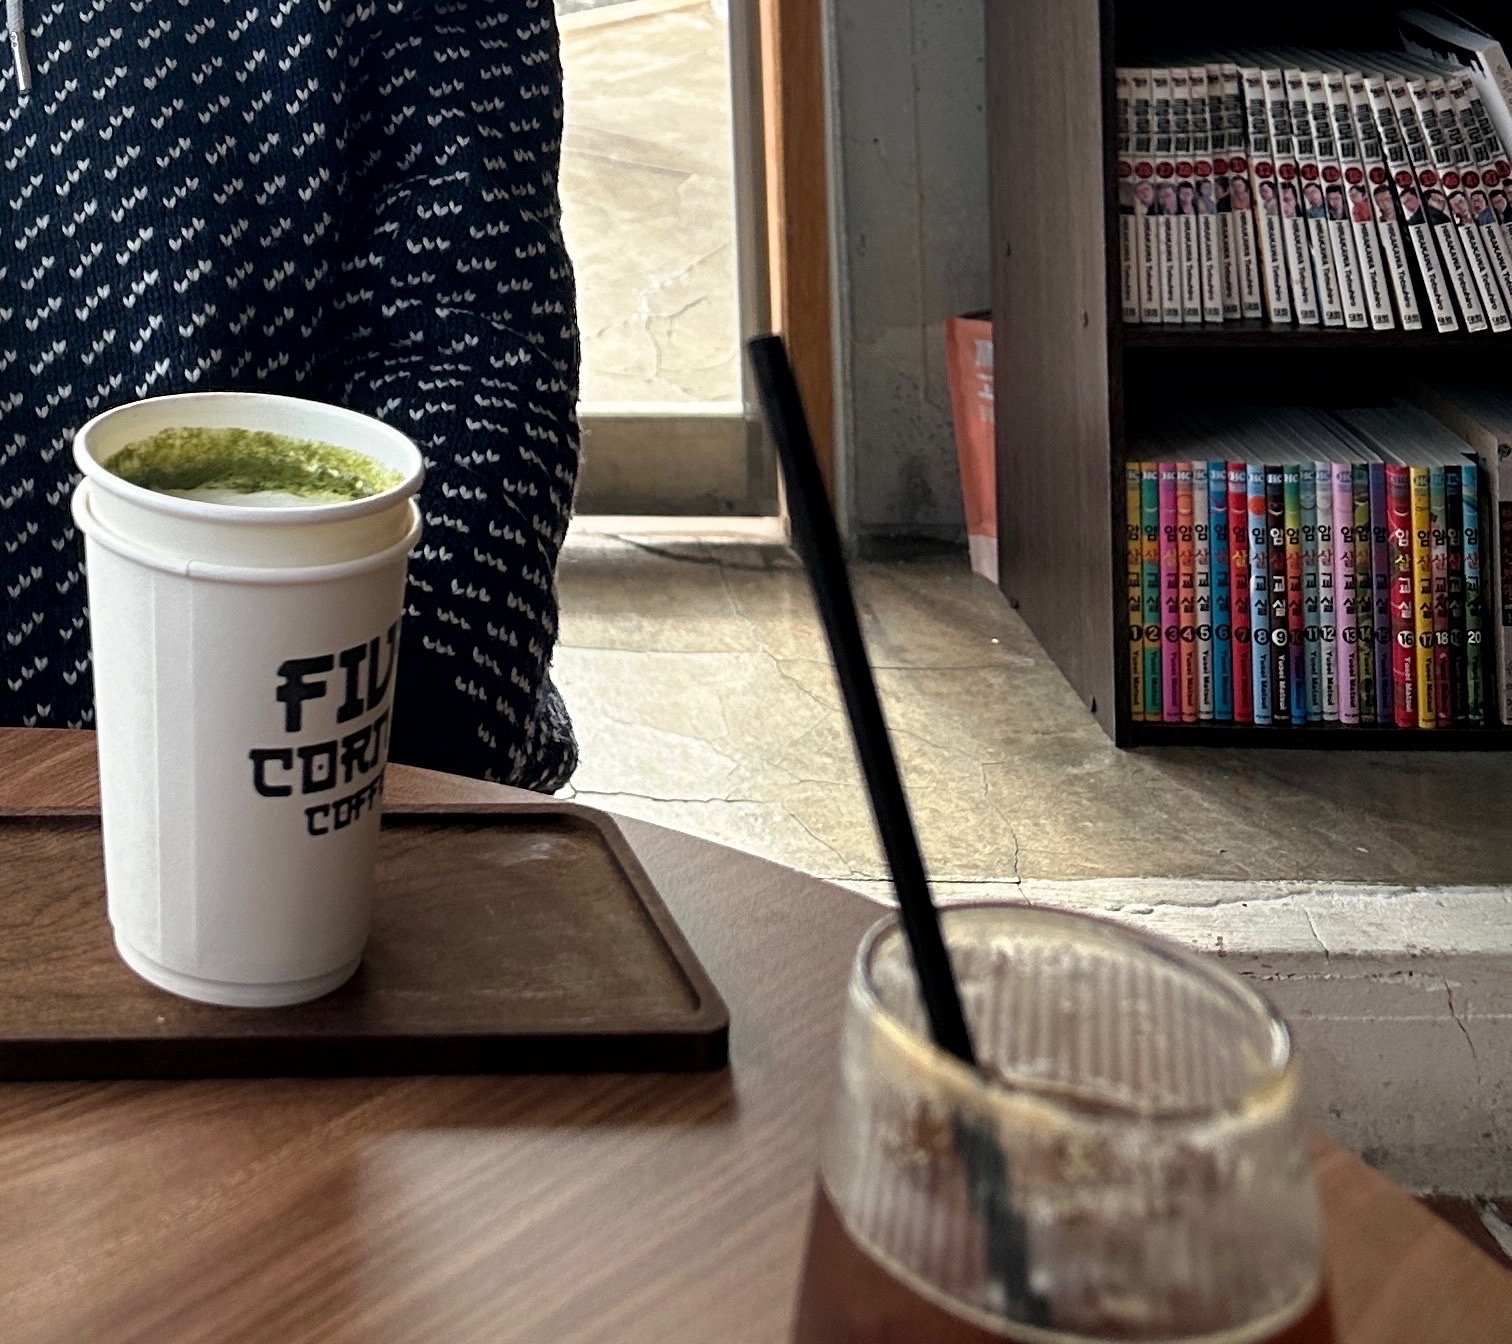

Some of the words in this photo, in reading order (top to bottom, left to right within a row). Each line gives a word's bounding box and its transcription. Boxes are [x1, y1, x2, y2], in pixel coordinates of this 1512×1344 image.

[1128, 525, 1140, 611] 암살교실
[1144, 525, 1158, 612] 암살교실
[1164, 525, 1177, 612] 암살교실
[1179, 525, 1193, 612] 암살교실
[1195, 524, 1209, 612] 암살교실
[1233, 525, 1248, 613] 암살교실
[1252, 528, 1267, 616] 암살교실
[1270, 528, 1286, 617] 암살교실
[1288, 528, 1302, 616] 암살교실
[1302, 525, 1318, 612] 암살교실
[1318, 525, 1333, 612] 암살교실
[1341, 526, 1355, 614] 암살교실
[1395, 529, 1412, 618] 암살교실
[1418, 531, 1433, 618] 암살교실
[1436, 631, 1448, 644] 18
[1468, 631, 1482, 644] 20
